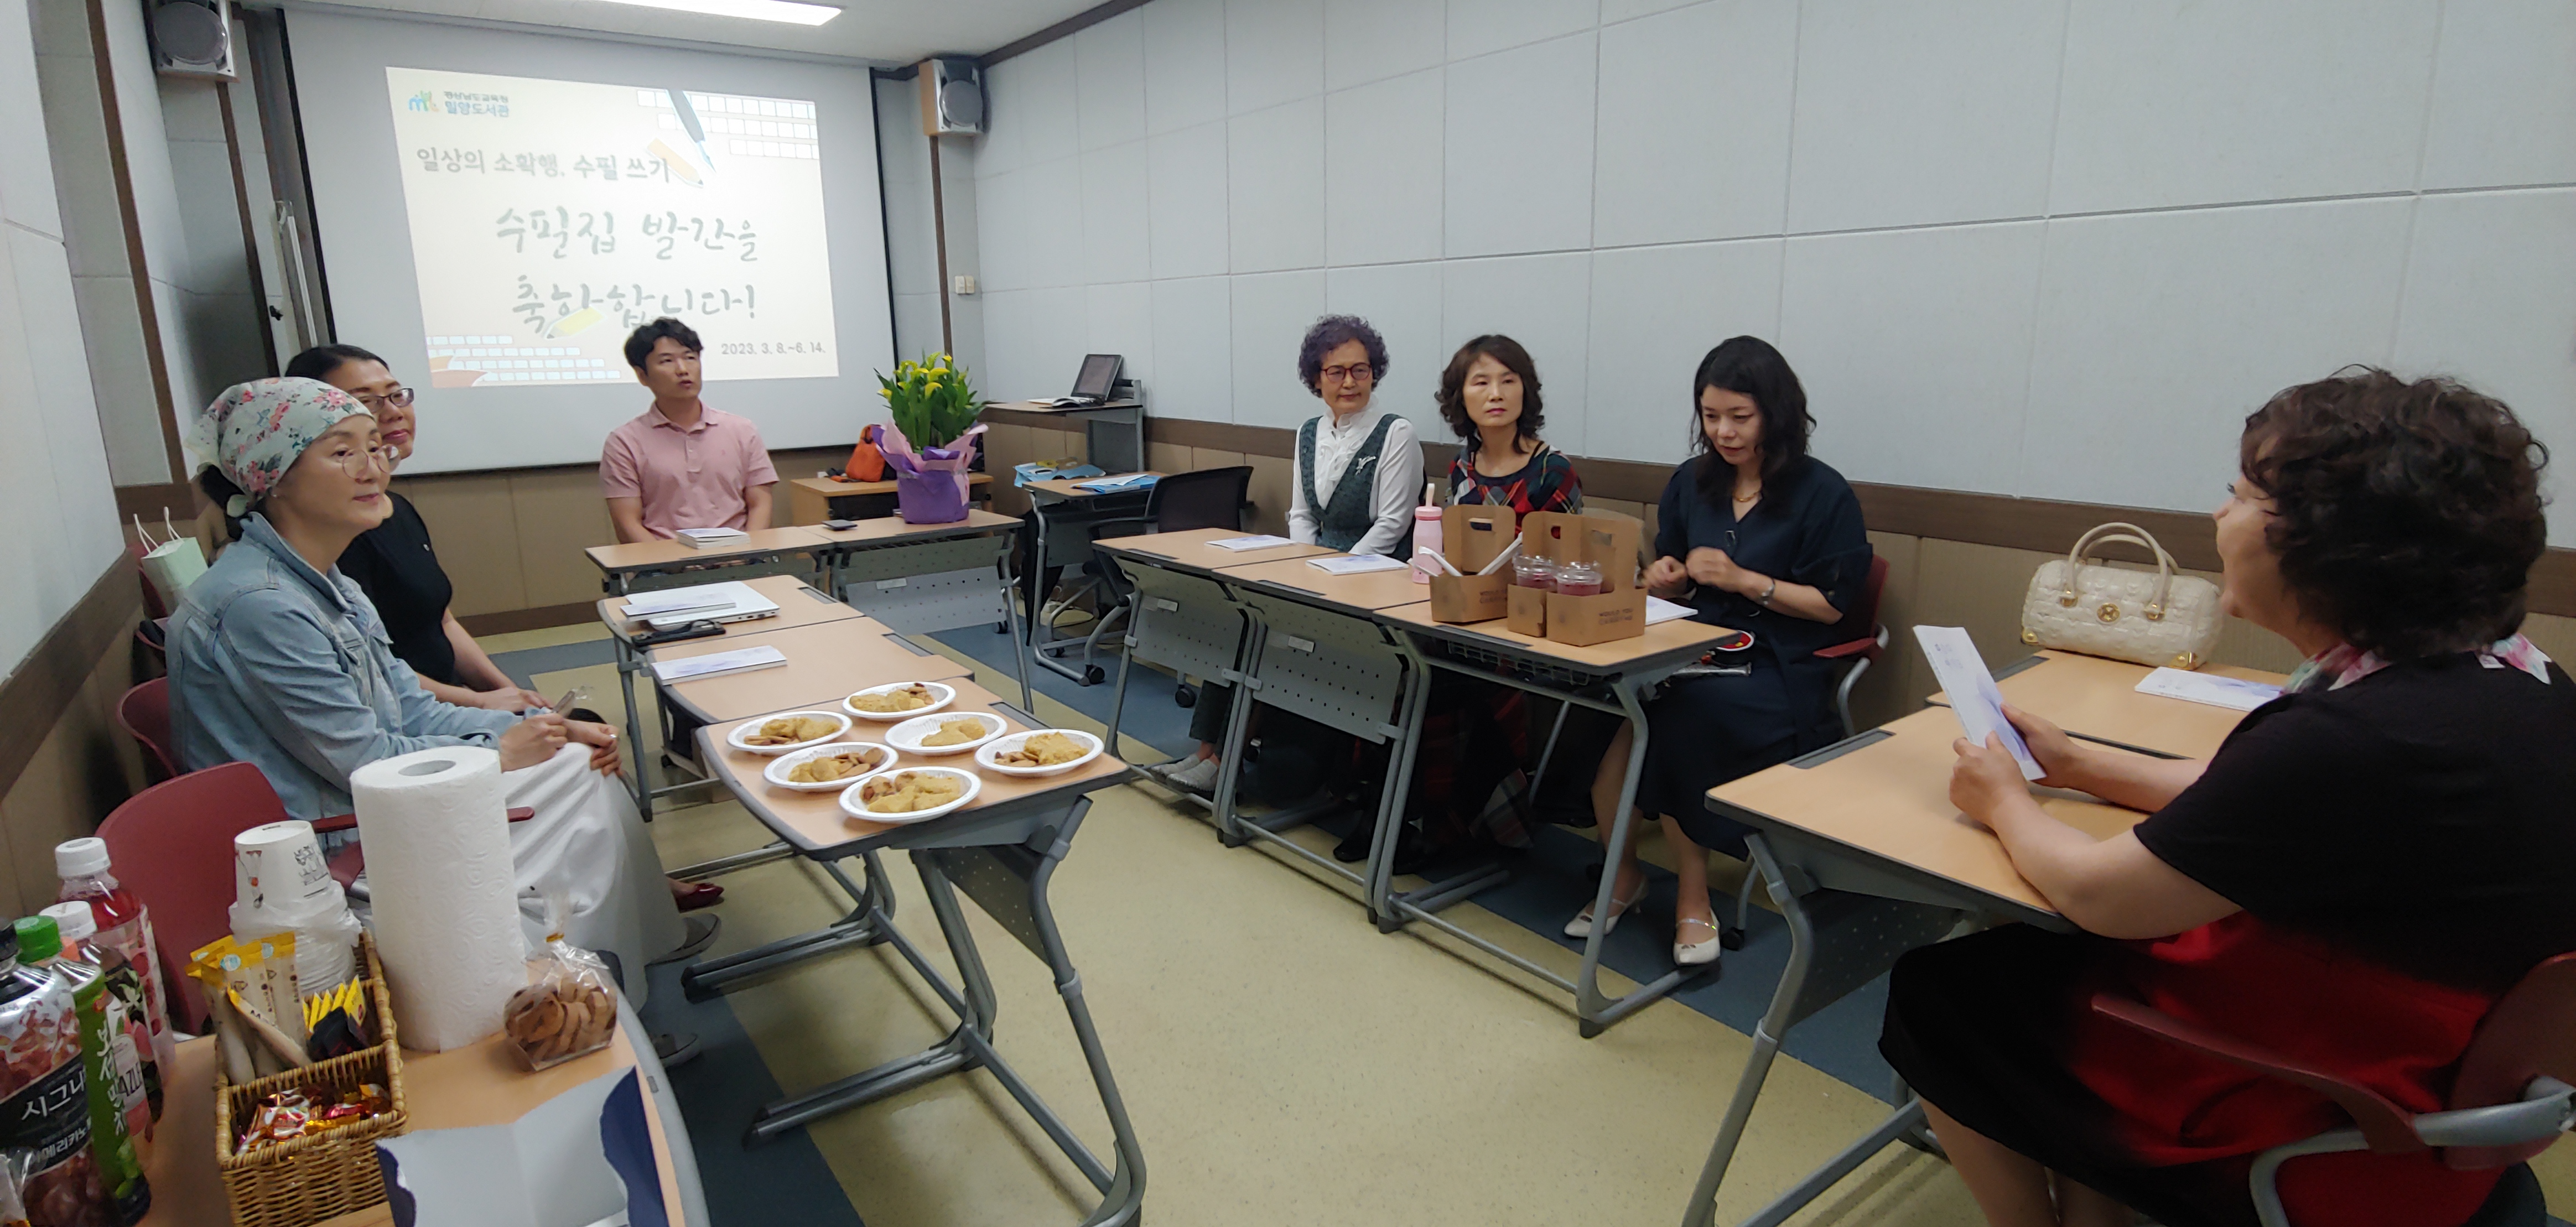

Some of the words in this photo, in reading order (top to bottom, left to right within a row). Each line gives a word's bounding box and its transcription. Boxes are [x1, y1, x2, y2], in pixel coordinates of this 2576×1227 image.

[444, 101, 510, 117] 밀양도서관
[417, 147, 485, 174] 일상의
[573, 154, 619, 180] 수필
[626, 158, 669, 183] 쓰기
[496, 205, 616, 259] 수필집
[642, 211, 758, 262] 발간을
[512, 274, 755, 334] 축하합니다!
[721, 342, 757, 355] 2023.
[761, 342, 773, 355] 3.
[809, 341, 826, 353] 14.
